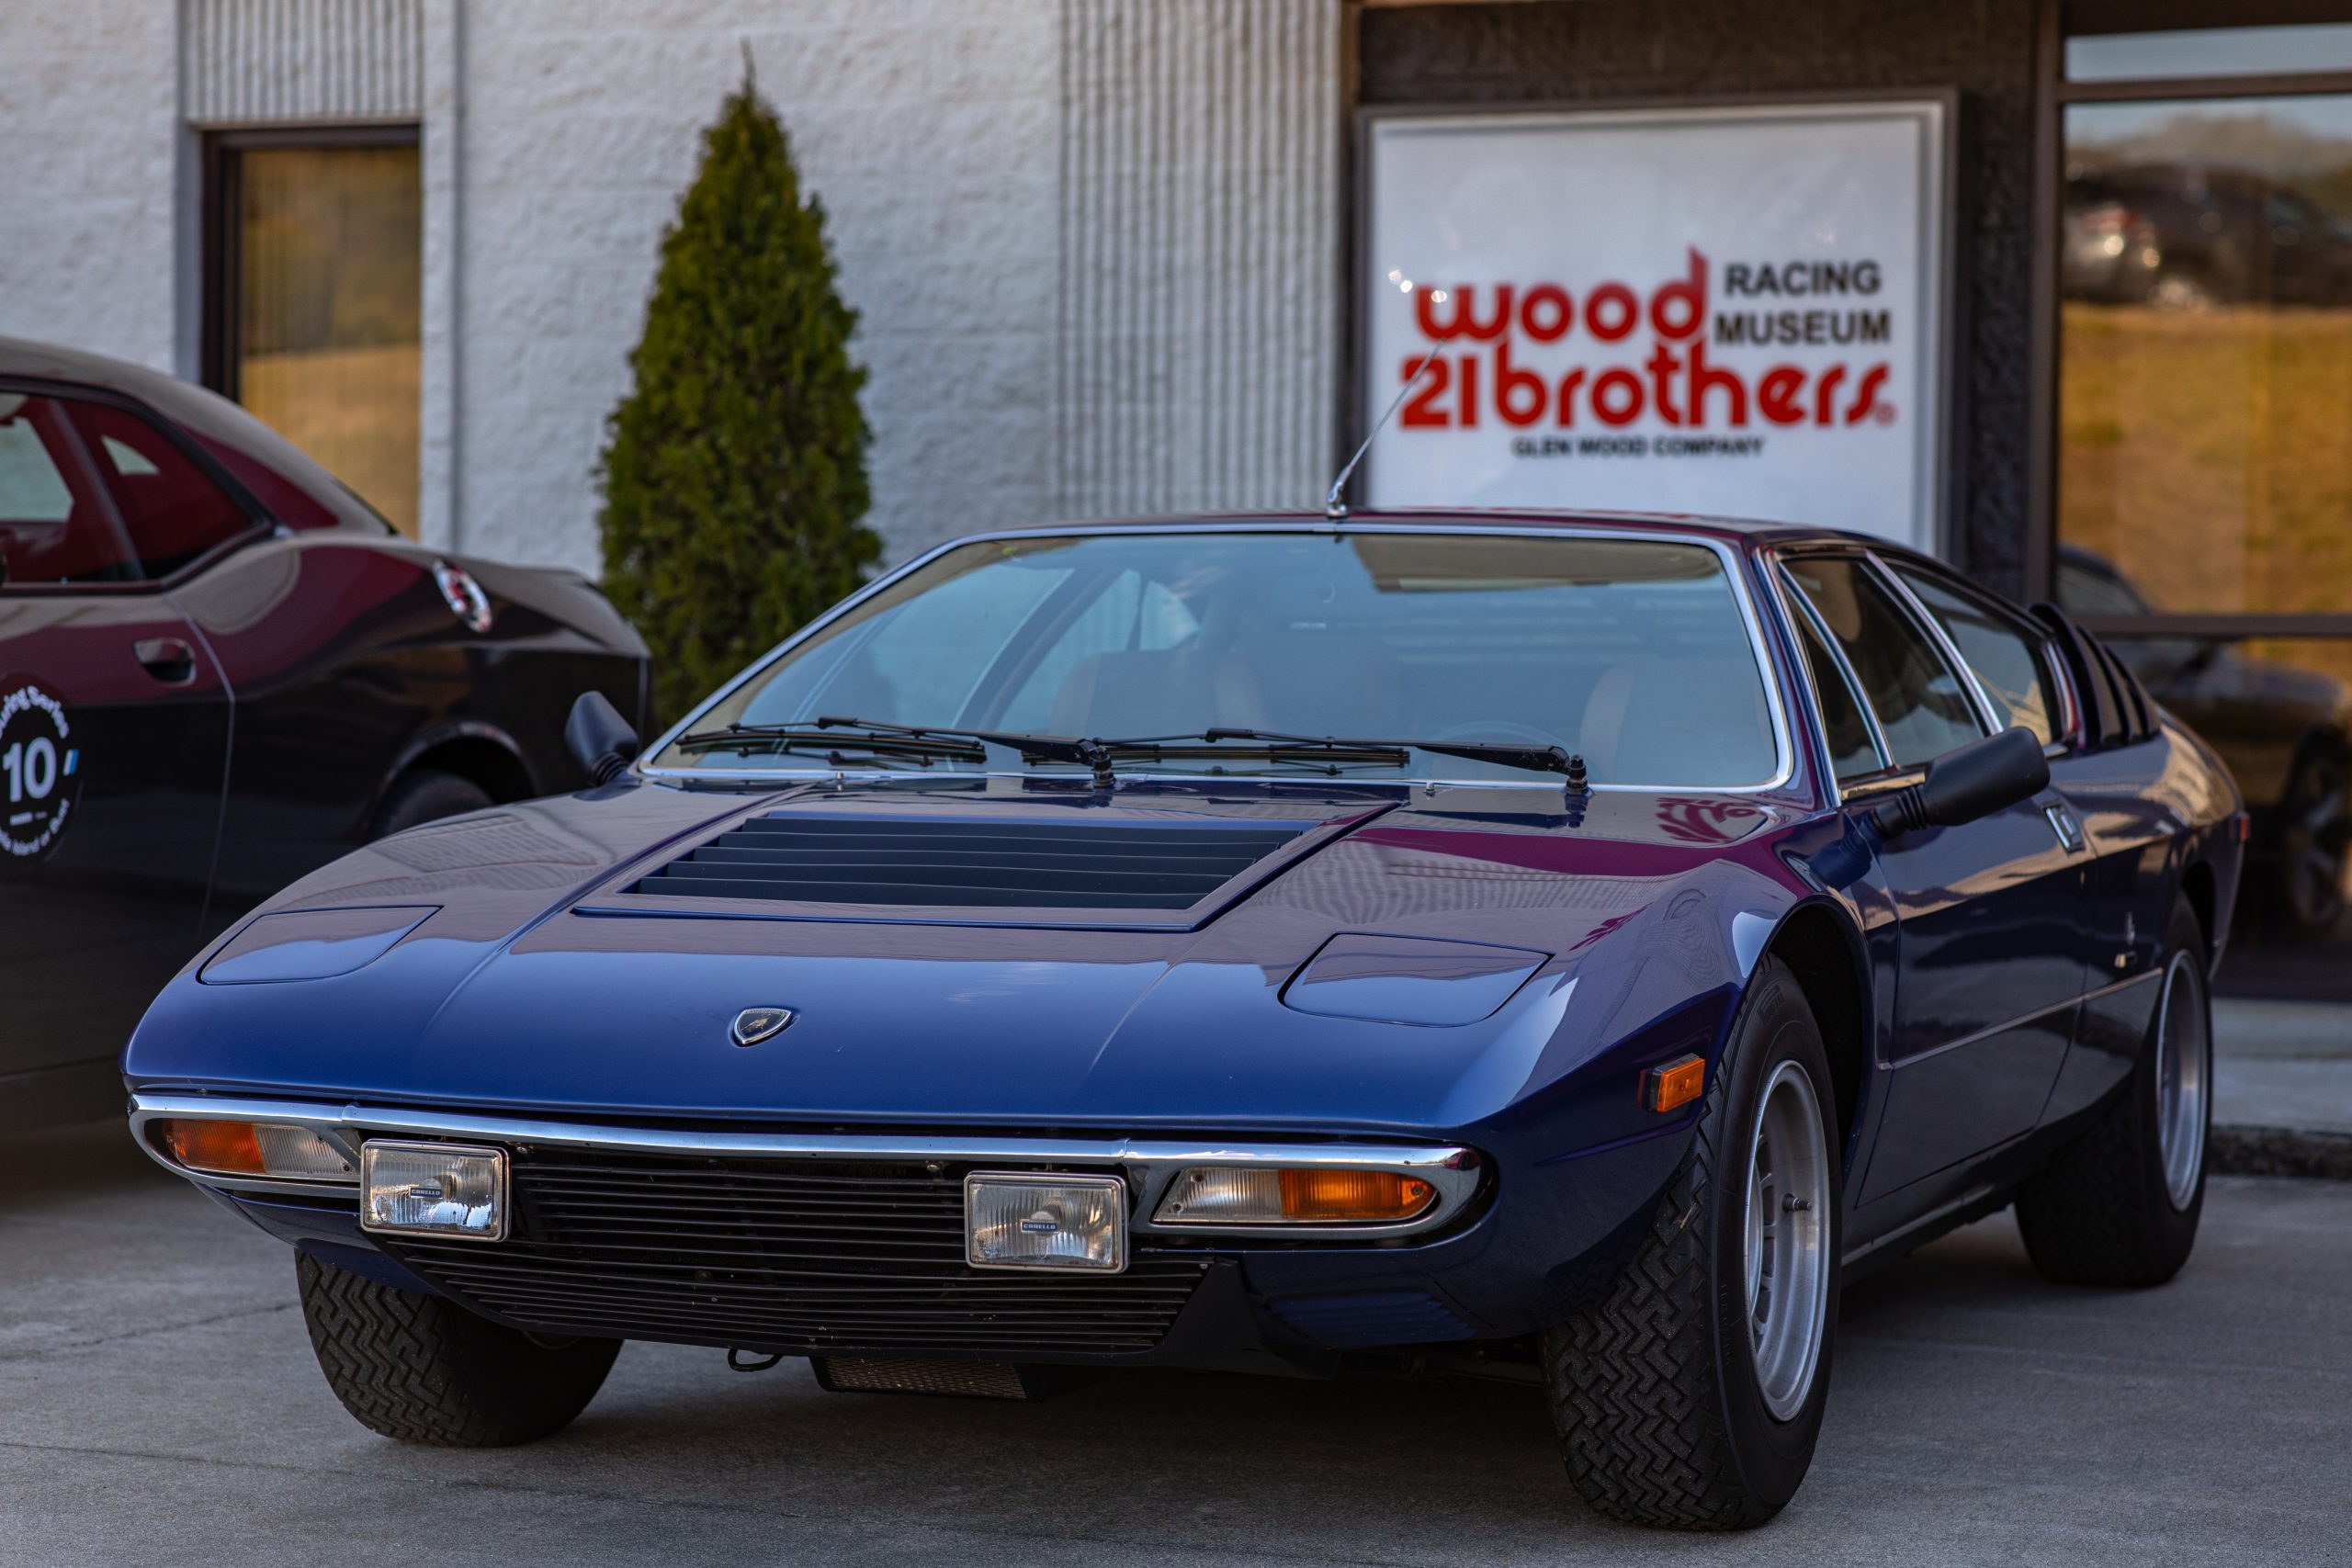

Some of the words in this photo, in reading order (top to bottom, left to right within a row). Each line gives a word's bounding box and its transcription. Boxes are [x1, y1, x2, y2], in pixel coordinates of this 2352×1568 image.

[1415, 245, 1708, 342] wood
[1724, 259, 1883, 298] RACING
[1714, 310, 1892, 346] MUSEUM
[1512, 436, 1573, 458] GLEN
[1575, 436, 1650, 458] WOOD
[1652, 435, 1766, 457] COMPANY
[3, 737, 57, 802] 10
